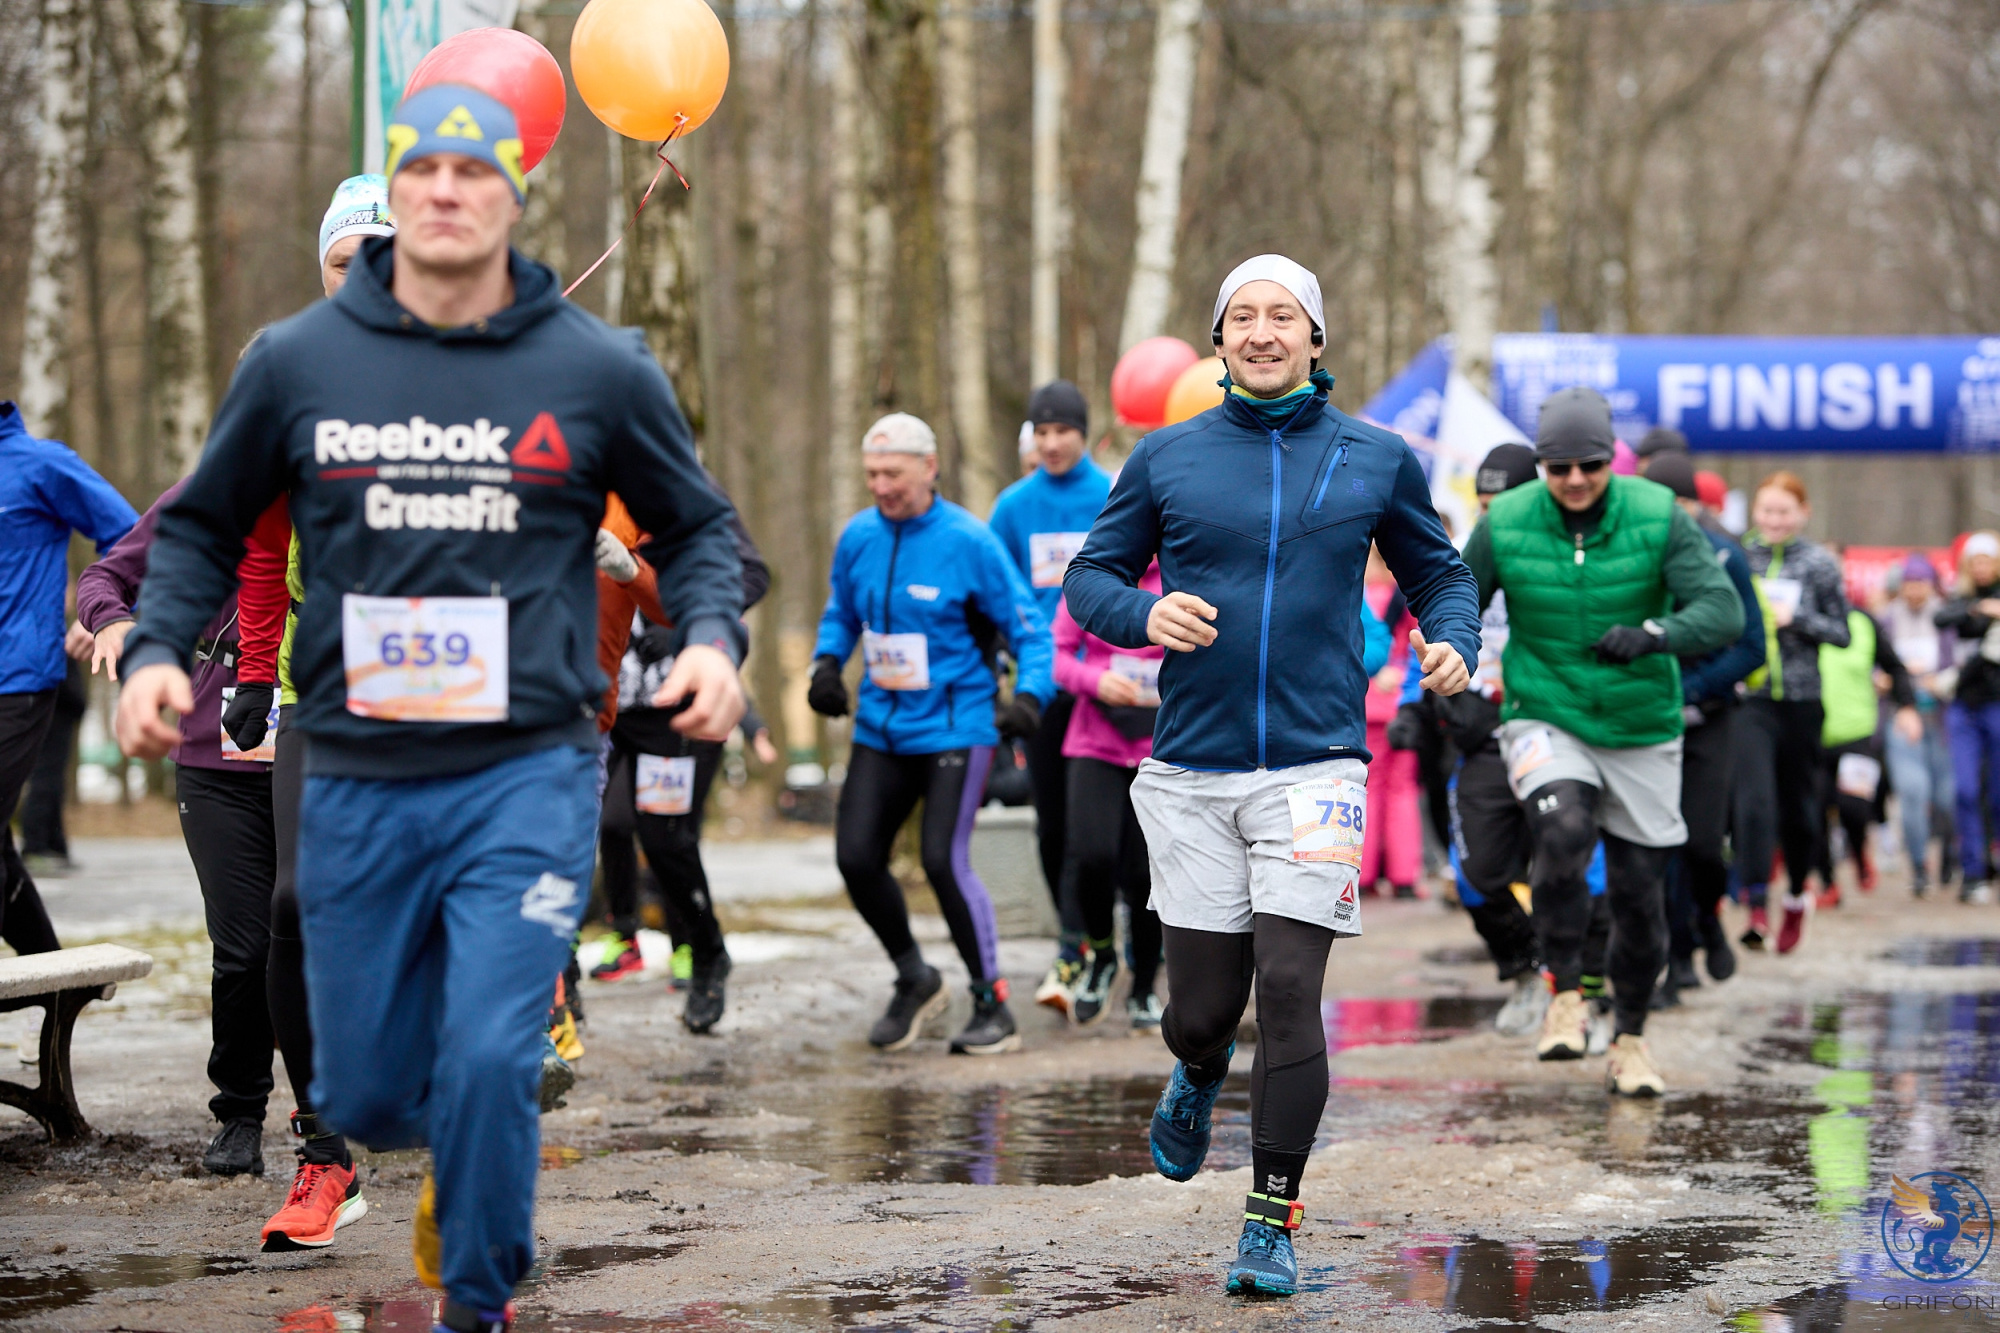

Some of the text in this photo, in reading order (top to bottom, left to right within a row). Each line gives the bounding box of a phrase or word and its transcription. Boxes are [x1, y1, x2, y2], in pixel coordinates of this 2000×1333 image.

[1657, 361, 1935, 431] FINISH
[315, 415, 511, 464] Reebok
[365, 483, 521, 533] CrossFit
[381, 632, 470, 667] 639
[1315, 800, 1363, 833] 738
[1334, 900, 1355, 912] Reebok
